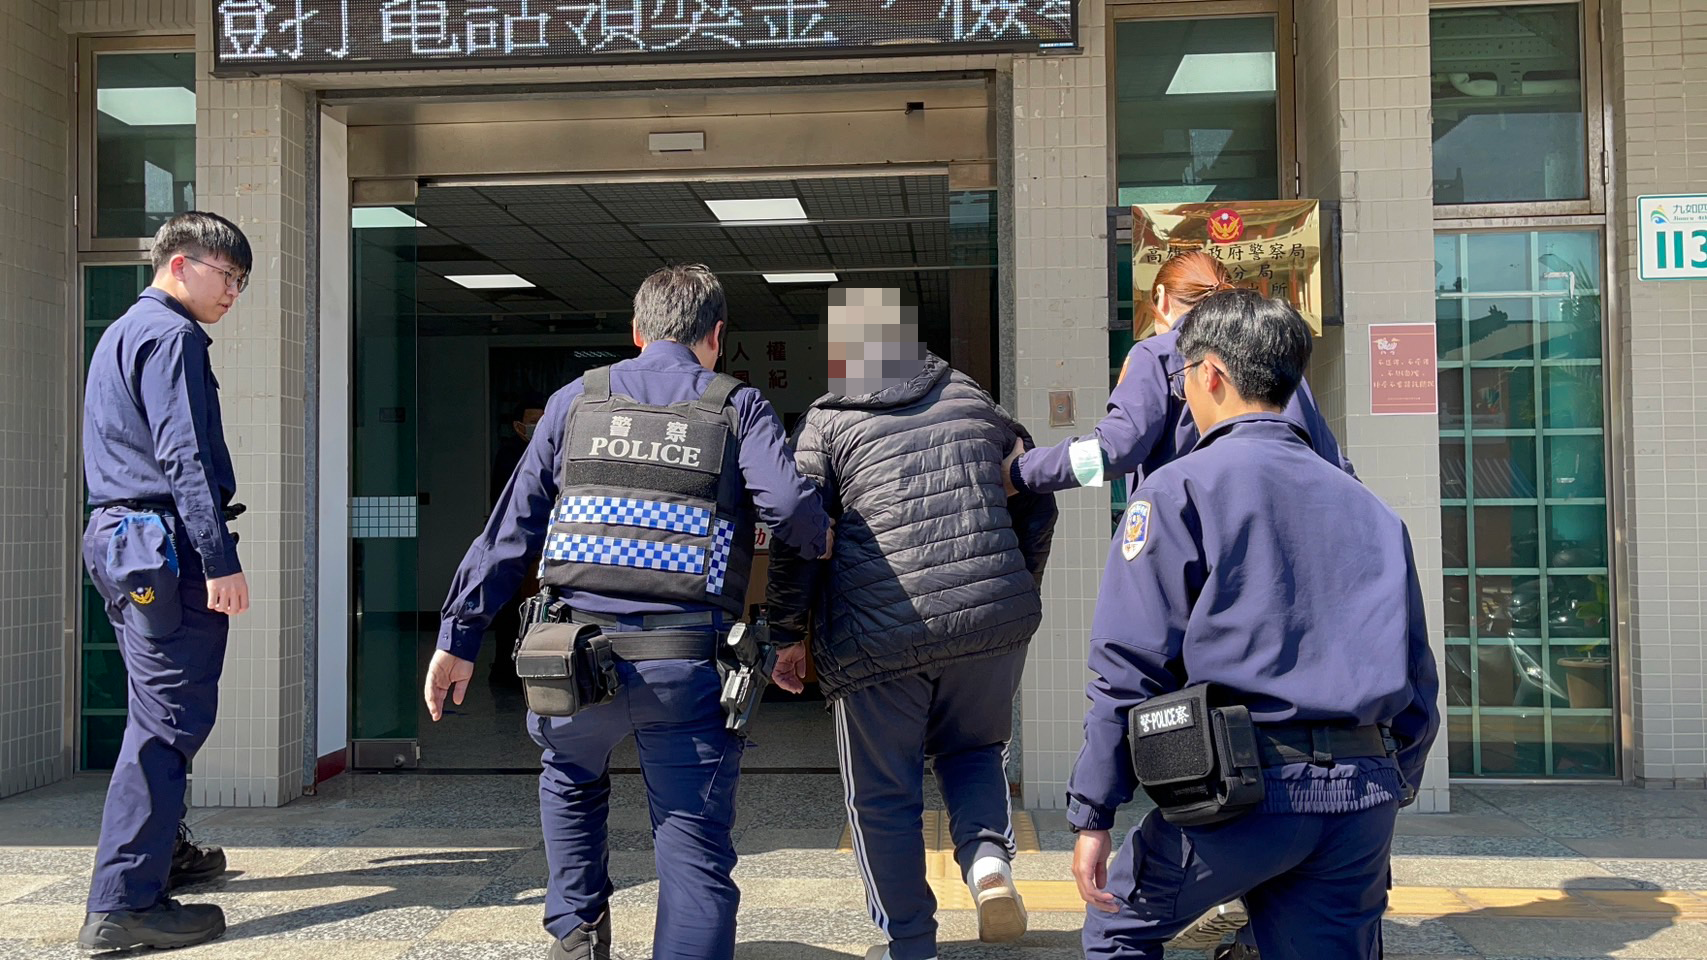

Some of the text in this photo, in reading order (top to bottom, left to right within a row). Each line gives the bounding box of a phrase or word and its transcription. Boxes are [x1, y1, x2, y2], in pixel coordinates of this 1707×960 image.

[1146, 243, 1306, 263] 高雄政府警察局
[1656, 229, 1707, 269] 113
[1232, 264, 1274, 280] 分局
[588, 437, 701, 467] POLICE
